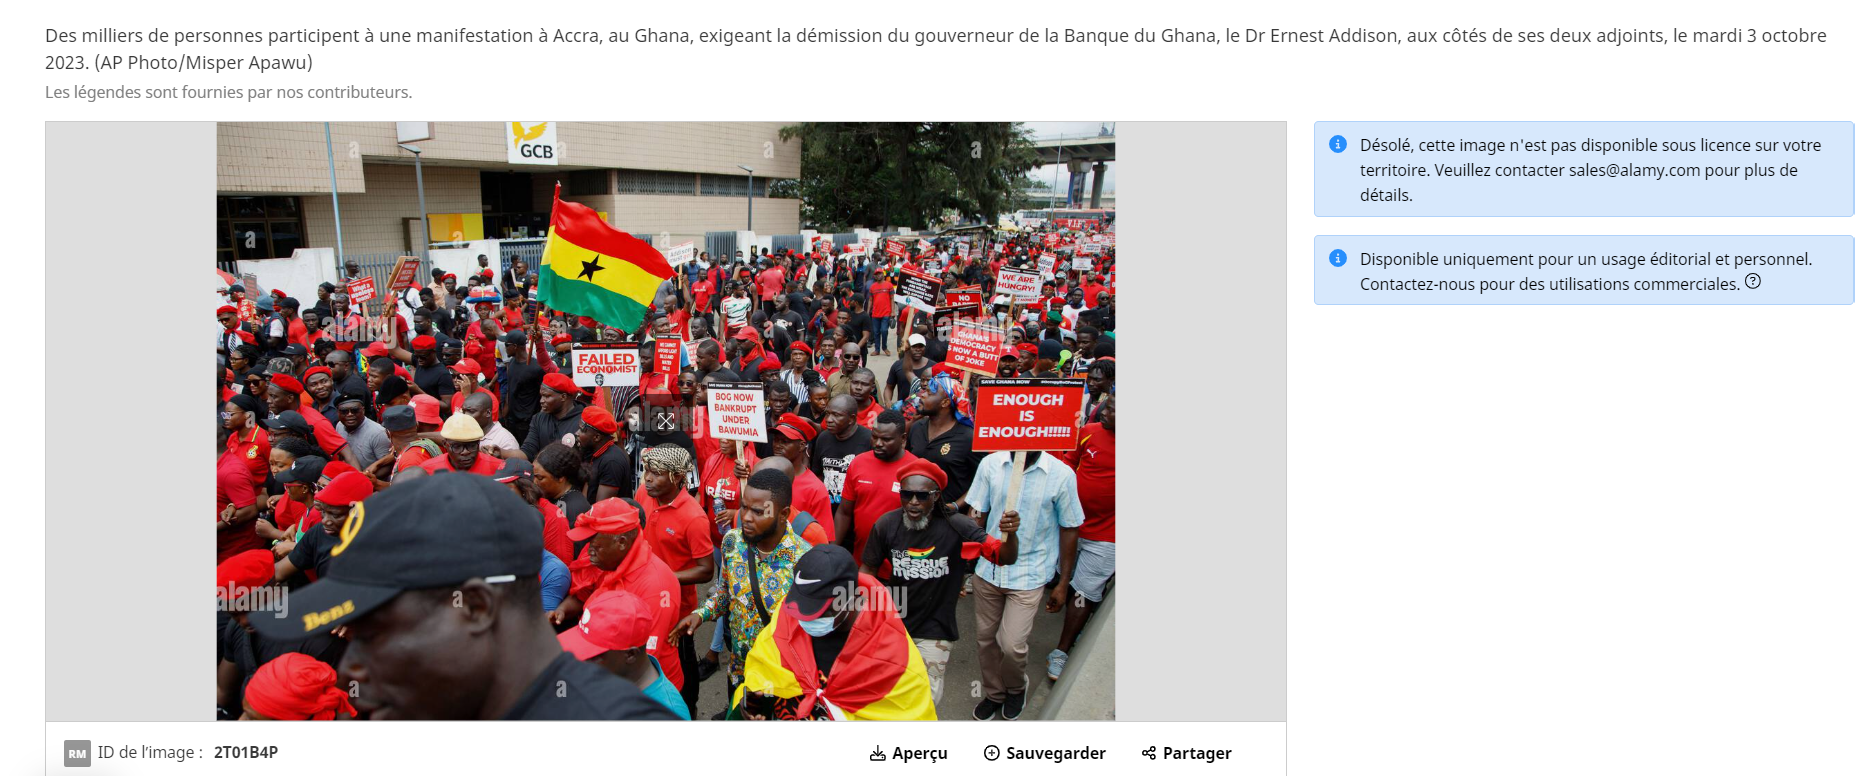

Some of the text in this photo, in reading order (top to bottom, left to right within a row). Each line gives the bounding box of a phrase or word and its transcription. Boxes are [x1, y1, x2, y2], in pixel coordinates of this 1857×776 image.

[520, 143, 554, 159] GCB
[1017, 276, 1035, 284] ARE
[998, 282, 1035, 292] HUNGRY!
[957, 331, 989, 342] GHANA'S
[950, 337, 996, 352] DEMOCRACY
[952, 345, 971, 354] NOW
[979, 352, 999, 361] BUTT
[578, 353, 635, 365] FAILED
[965, 357, 985, 366] JOKE
[576, 365, 638, 374] ECONOMIST
[715, 392, 754, 402] BOG NOW
[992, 394, 1064, 406] ENOUGH
[714, 403, 757, 413] BANKRUPT
[722, 415, 750, 425] UNDER
[1018, 410, 1035, 422] IS
[718, 425, 759, 437] BAWUMIA
[978, 426, 1071, 438] ENOUGH!!!!!
